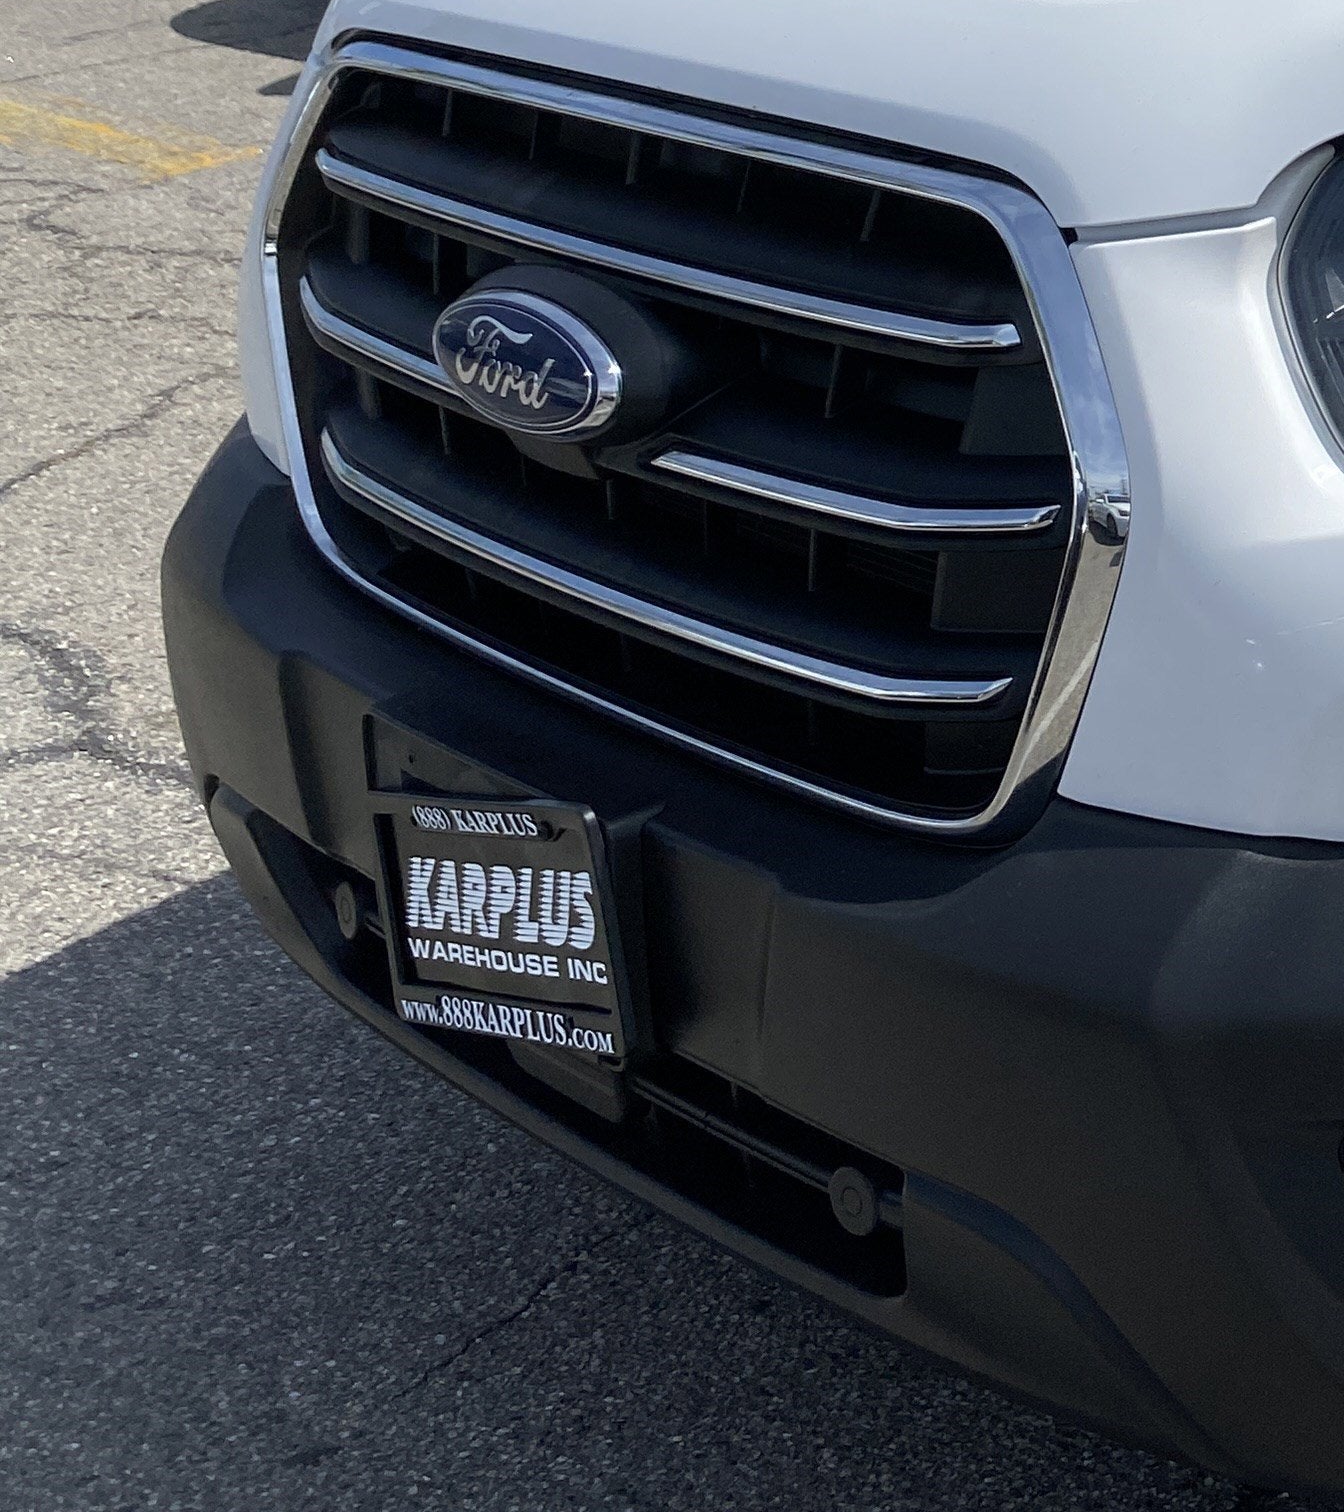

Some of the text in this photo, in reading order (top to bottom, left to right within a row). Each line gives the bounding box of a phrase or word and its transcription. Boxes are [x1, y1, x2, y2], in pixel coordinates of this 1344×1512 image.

[455, 315, 556, 410] Ford
[411, 805, 539, 837] (888) KARPLUS
[405, 856, 596, 951] KARPLUS
[408, 937, 608, 985] WAREHOUSE INC
